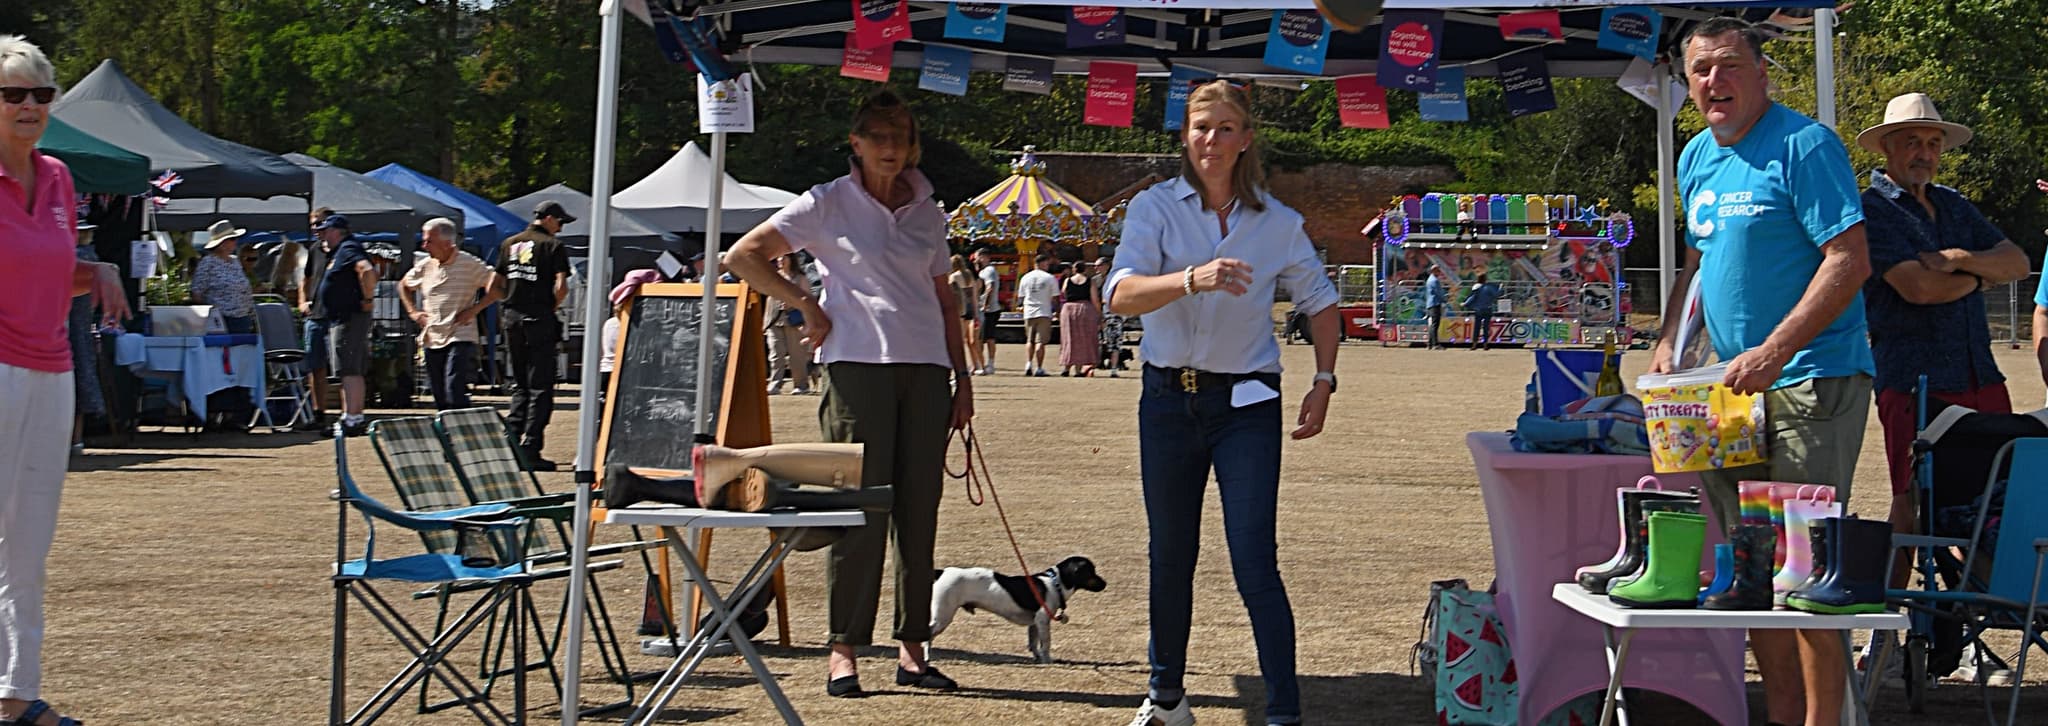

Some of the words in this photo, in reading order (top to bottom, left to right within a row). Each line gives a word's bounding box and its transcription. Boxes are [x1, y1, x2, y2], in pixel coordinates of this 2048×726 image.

[1282, 12, 1317, 23] Together
[1297, 31, 1324, 40] cancer
[1391, 30, 1426, 41] Together
[1402, 40, 1417, 48] will
[1388, 47, 1406, 55] beat
[1407, 50, 1434, 58] cancer
[846, 59, 883, 71] beating
[924, 70, 961, 82] beating
[1505, 77, 1544, 92] beating
[1090, 89, 1128, 101] beating
[1342, 102, 1380, 111] beating
[1440, 320, 1569, 342] KIZONE
[1661, 403, 1708, 417] TREATS
